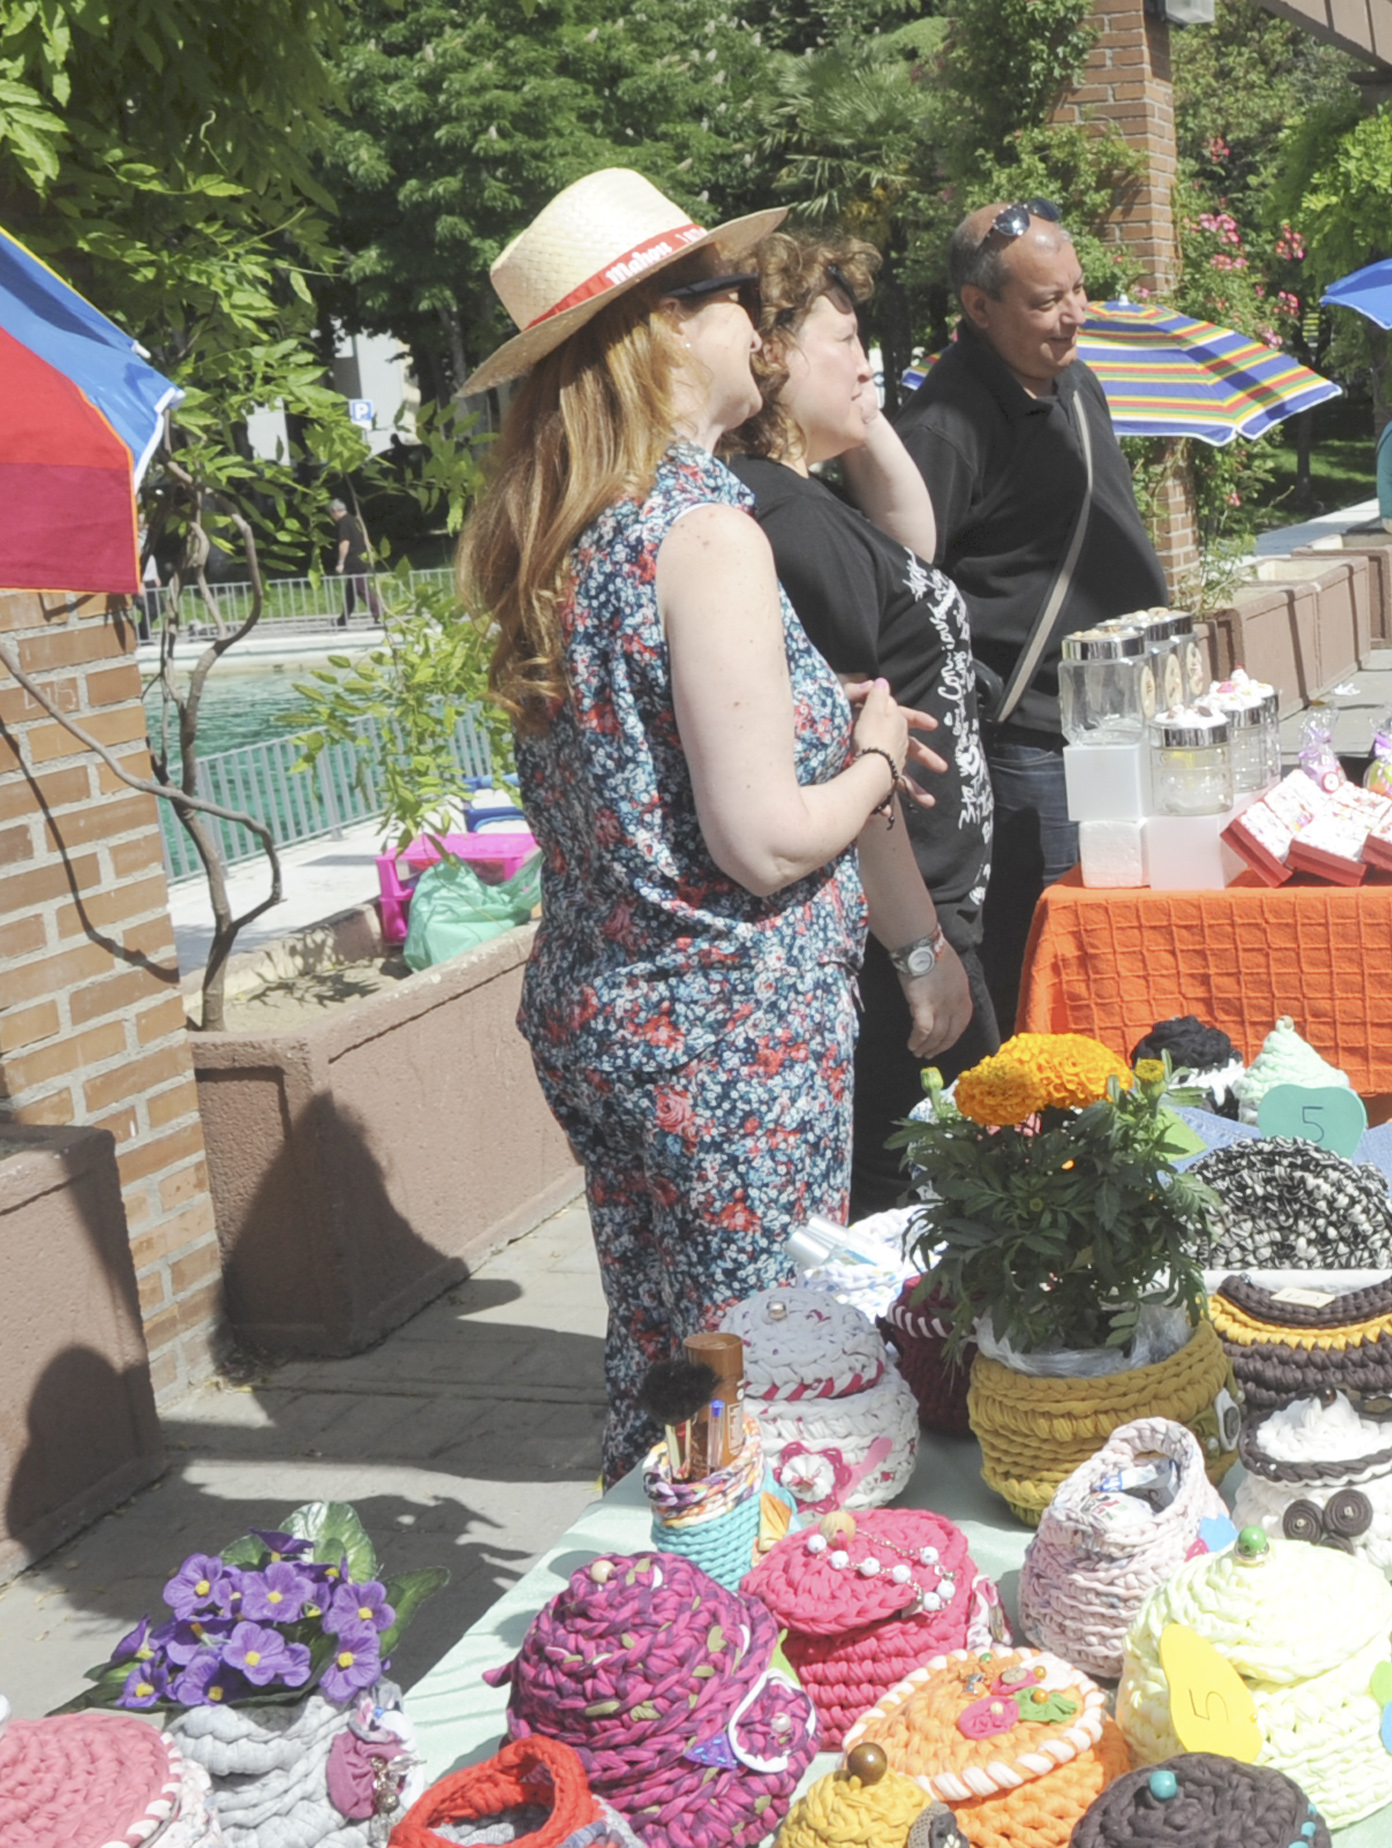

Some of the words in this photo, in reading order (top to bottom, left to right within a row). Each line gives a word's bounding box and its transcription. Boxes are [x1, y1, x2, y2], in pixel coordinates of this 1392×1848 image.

[605, 240, 673, 286] Mahou
[354, 402, 369, 420] P
[1301, 1105, 1325, 1142] 5
[1187, 1687, 1231, 1725] 5
